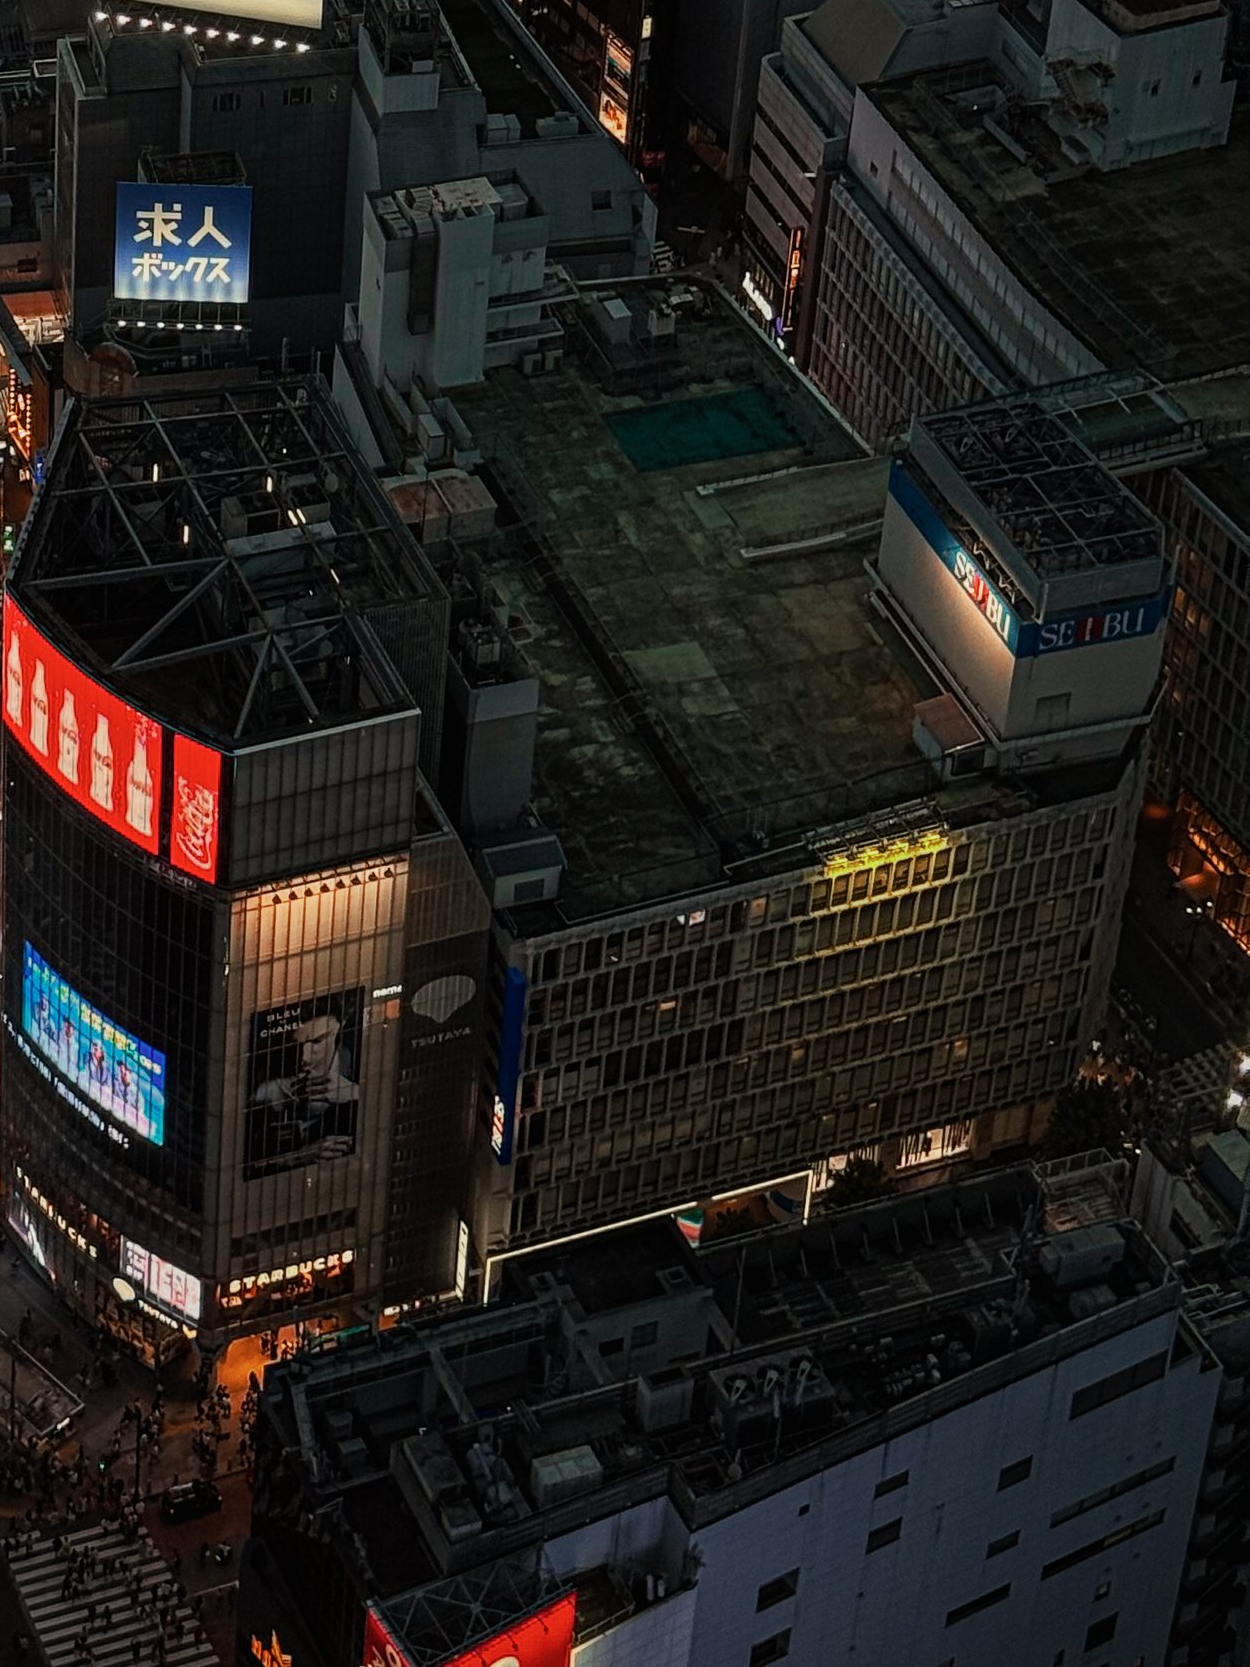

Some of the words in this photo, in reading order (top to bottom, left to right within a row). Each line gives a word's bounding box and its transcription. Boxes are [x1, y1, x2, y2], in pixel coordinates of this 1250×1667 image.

[133, 202, 232, 249] 求人
[131, 253, 232, 283] ボックス
[954, 551, 1011, 647] SEIBU
[1039, 606, 1145, 651] SEIBU
[259, 1020, 302, 1038] CHANEL
[266, 1007, 301, 1024] BLEU
[411, 1026, 472, 1048] TSUTAYA
[15, 1164, 99, 1261] STARBUCKS
[229, 1248, 354, 1294] STARBUCKS
